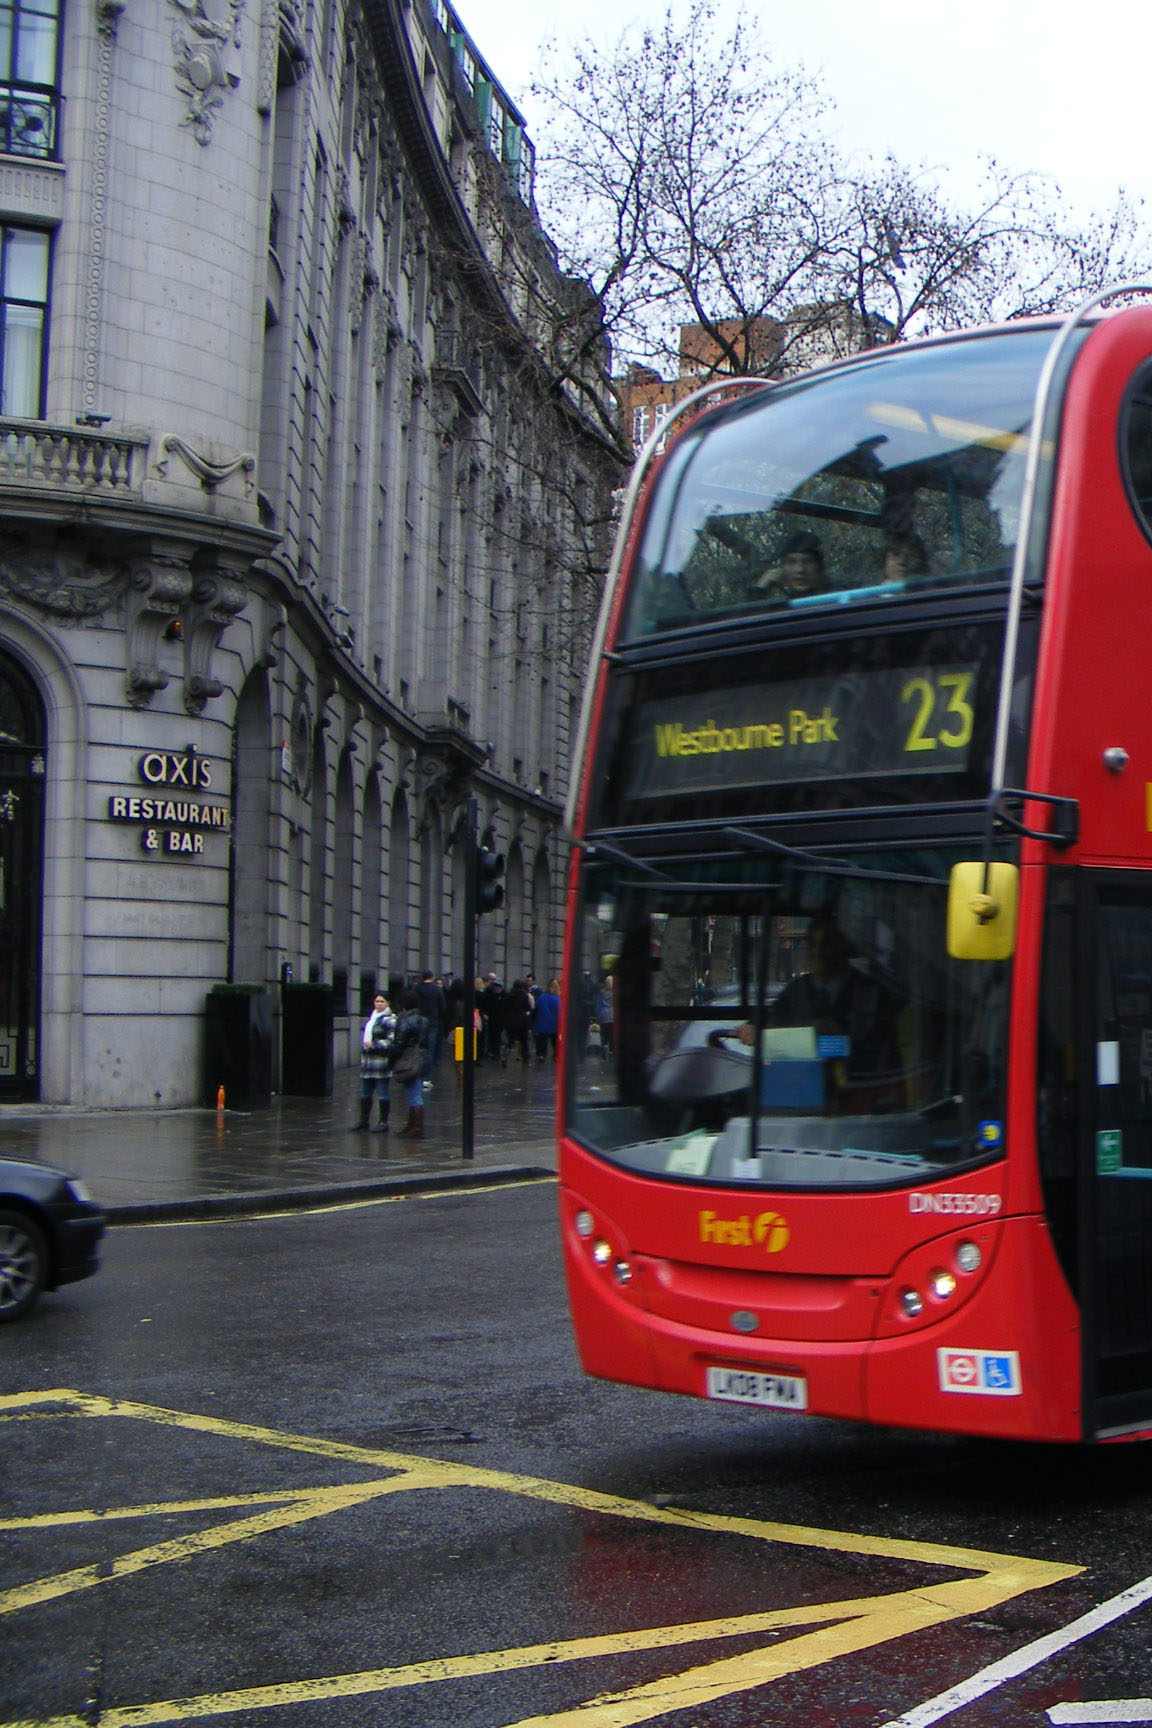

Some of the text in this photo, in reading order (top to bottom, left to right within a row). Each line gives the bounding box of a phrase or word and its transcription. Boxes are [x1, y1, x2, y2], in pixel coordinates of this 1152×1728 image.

[901, 672, 975, 752] 23
[655, 707, 840, 758] Westbourne Park
[143, 744, 212, 788] axis
[113, 796, 229, 827] RESTAURANT
[146, 829, 204, 853] & BAR
[909, 1193, 1002, 1215] DN33509
[700, 1210, 753, 1246] First
